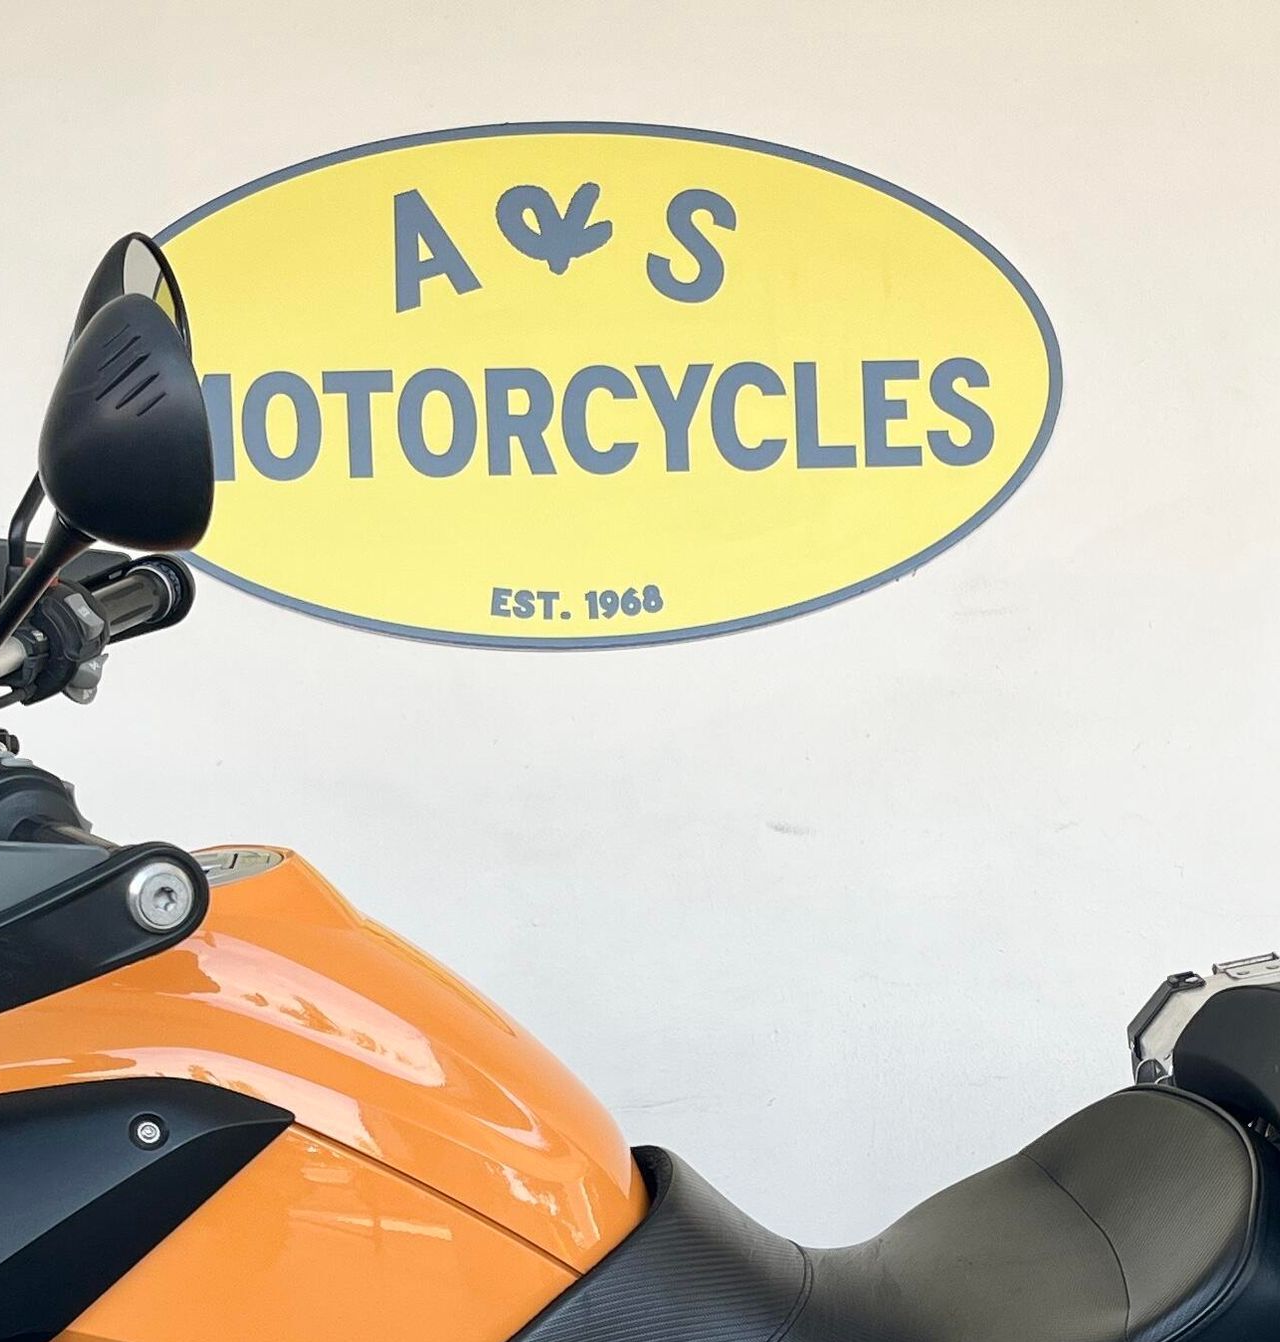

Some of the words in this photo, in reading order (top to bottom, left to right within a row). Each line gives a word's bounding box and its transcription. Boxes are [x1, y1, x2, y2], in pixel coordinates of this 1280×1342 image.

[393, 188, 483, 314] A
[646, 188, 737, 304] S
[490, 586, 572, 620] EST.
[584, 584, 664, 620] 1968
